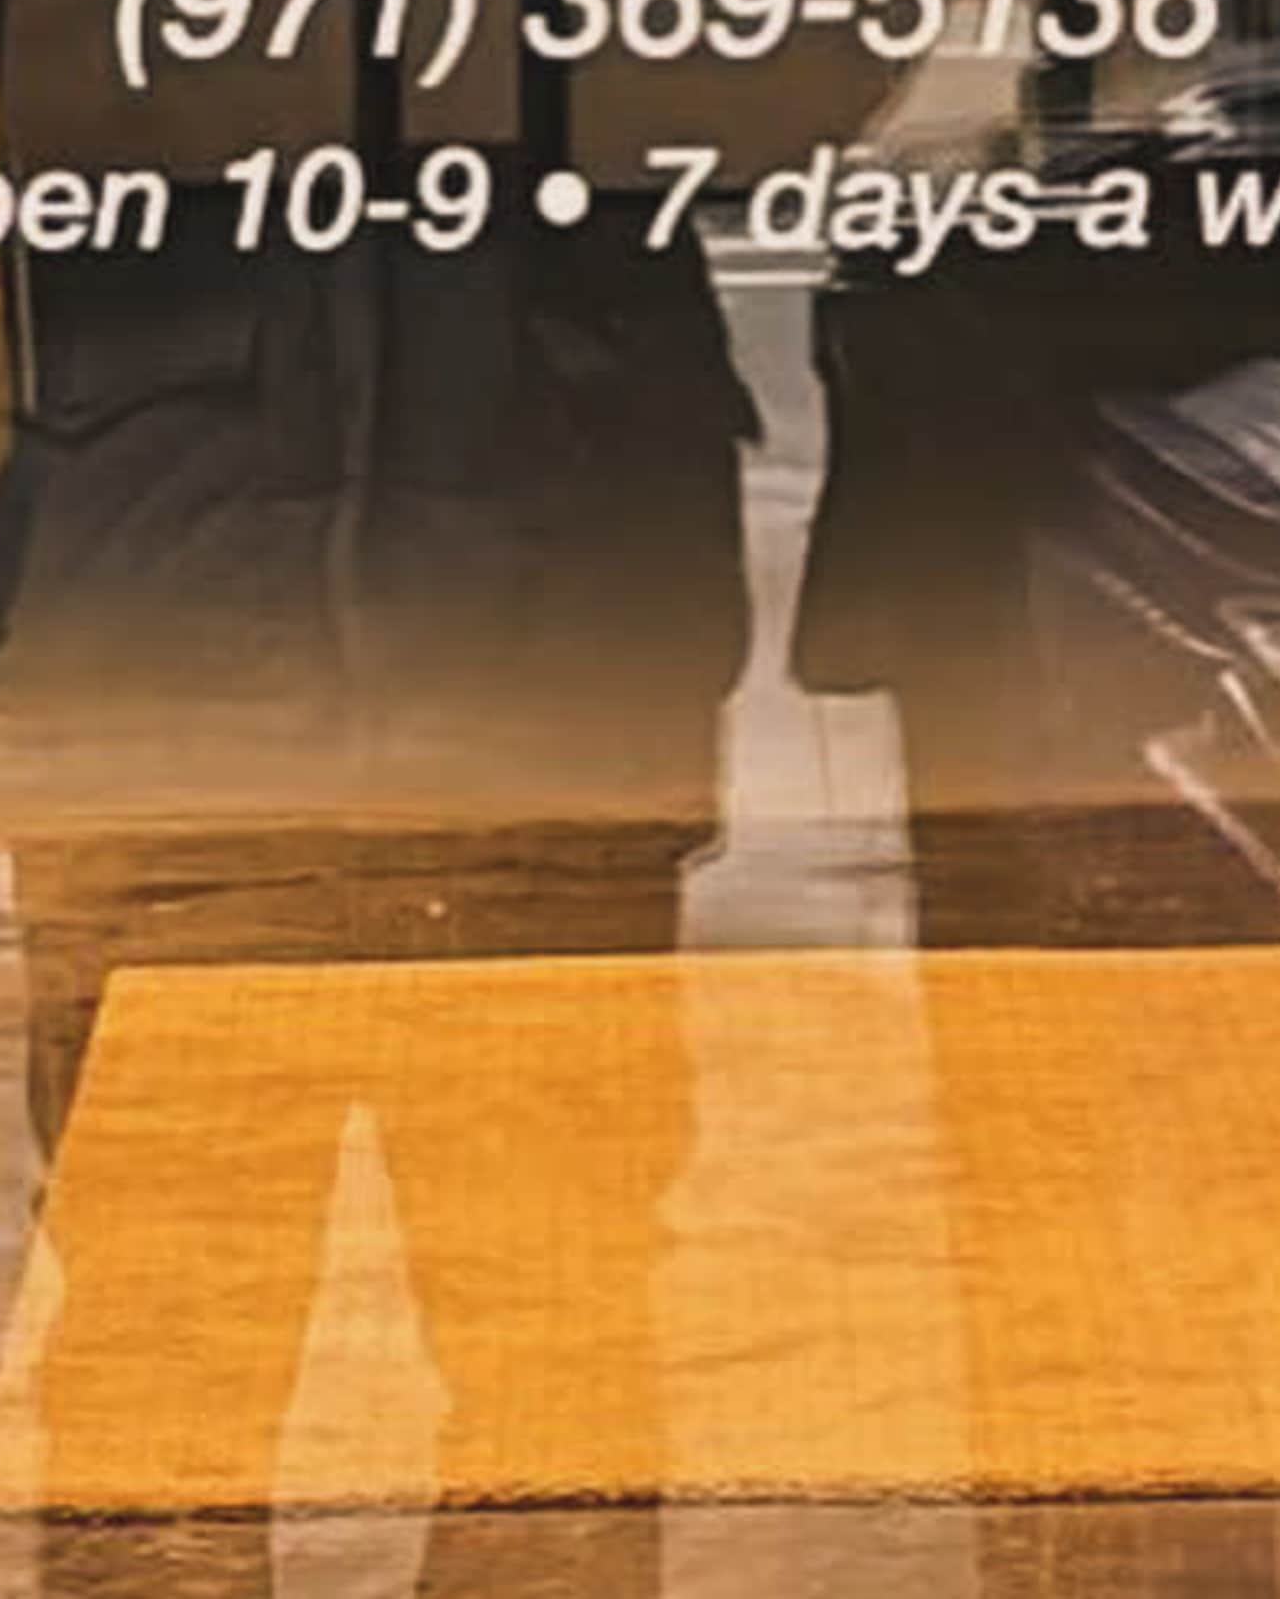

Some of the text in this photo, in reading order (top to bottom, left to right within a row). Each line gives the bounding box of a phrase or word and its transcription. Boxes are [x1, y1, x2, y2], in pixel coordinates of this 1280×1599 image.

[224, 146, 491, 251] 10-9
[644, 147, 718, 250] 7
[747, 144, 1039, 276] days
[1076, 167, 1150, 249] a
